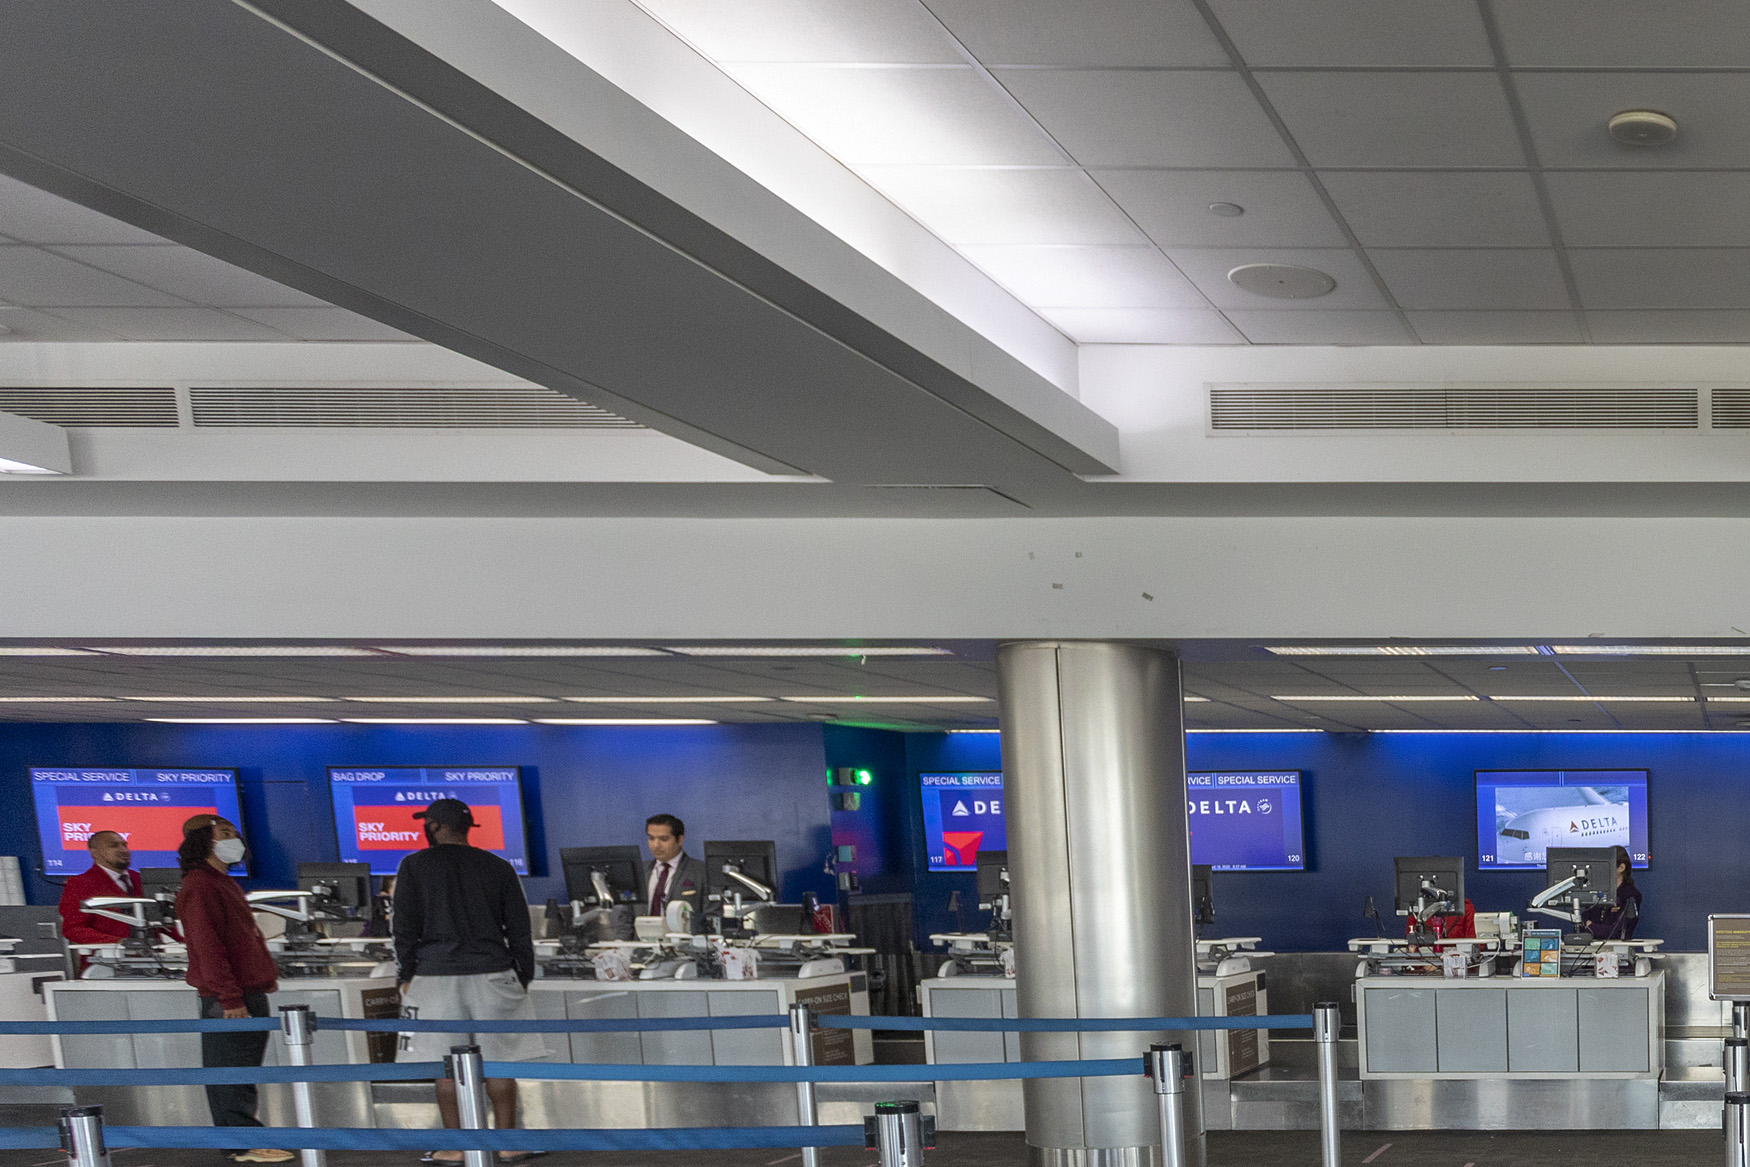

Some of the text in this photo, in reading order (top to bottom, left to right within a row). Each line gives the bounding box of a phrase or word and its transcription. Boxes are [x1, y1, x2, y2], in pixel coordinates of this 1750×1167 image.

[35, 772, 130, 782] SPECIAL SERVICE
[157, 773, 231, 783] SKY PRIORITY
[333, 772, 385, 782] BAG DROP
[445, 772, 514, 781] SKY PRIORITY
[923, 776, 1000, 786] SPECIAL SERVICE
[1218, 775, 1296, 784] SPECIAL SERVICE
[116, 792, 159, 801] DELTA
[407, 791, 446, 801] DELTA
[63, 823, 92, 832] SKY
[358, 823, 384, 832] SKY
[1581, 816, 1618, 830] DELTA
[360, 831, 419, 842] PRIORITY
[1633, 853, 1646, 861] 122
